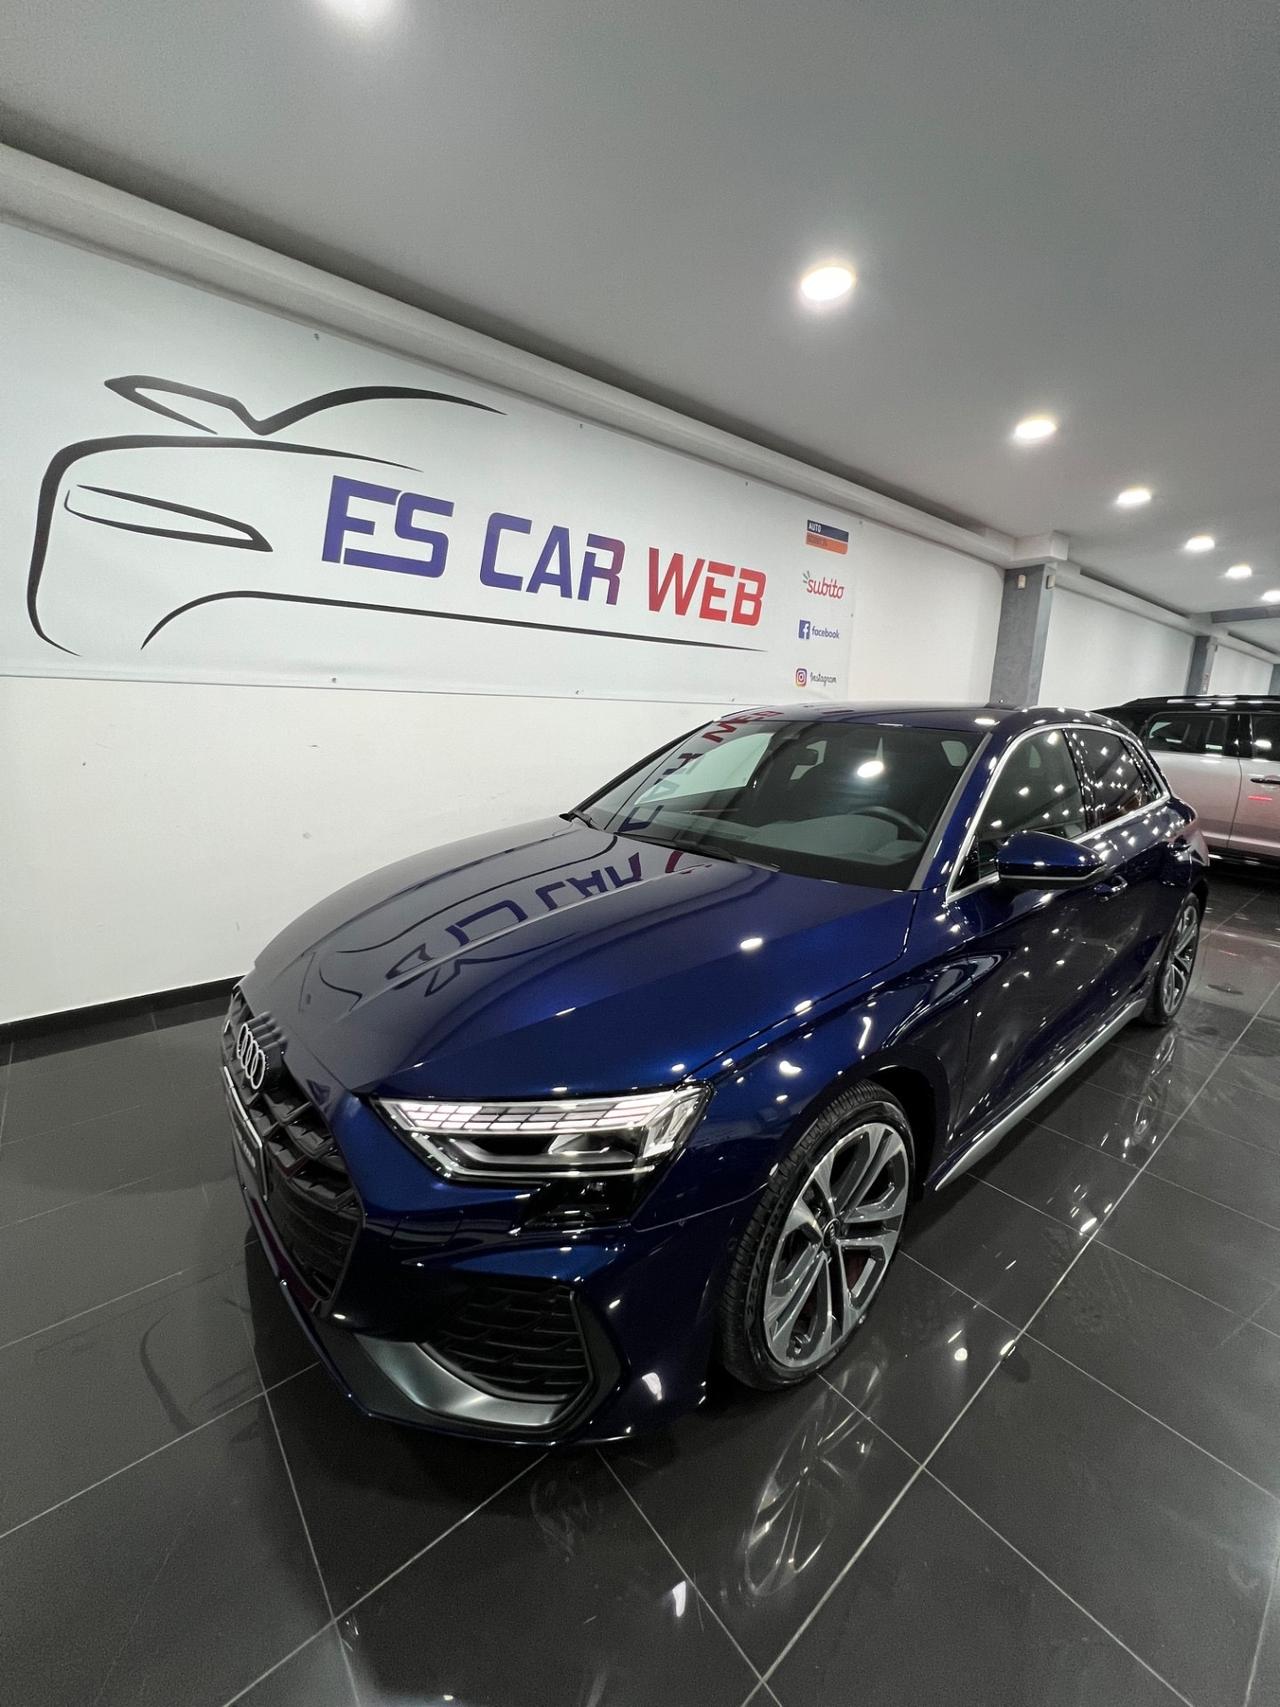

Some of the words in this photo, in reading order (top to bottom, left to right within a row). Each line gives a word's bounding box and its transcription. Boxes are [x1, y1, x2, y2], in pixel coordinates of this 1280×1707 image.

[808, 523, 822, 533] AUTO
[322, 475, 455, 578] ES
[480, 512, 625, 605] CAR
[648, 547, 767, 626] WEB
[807, 577, 844, 600] subito
[811, 626, 840, 639] facebook
